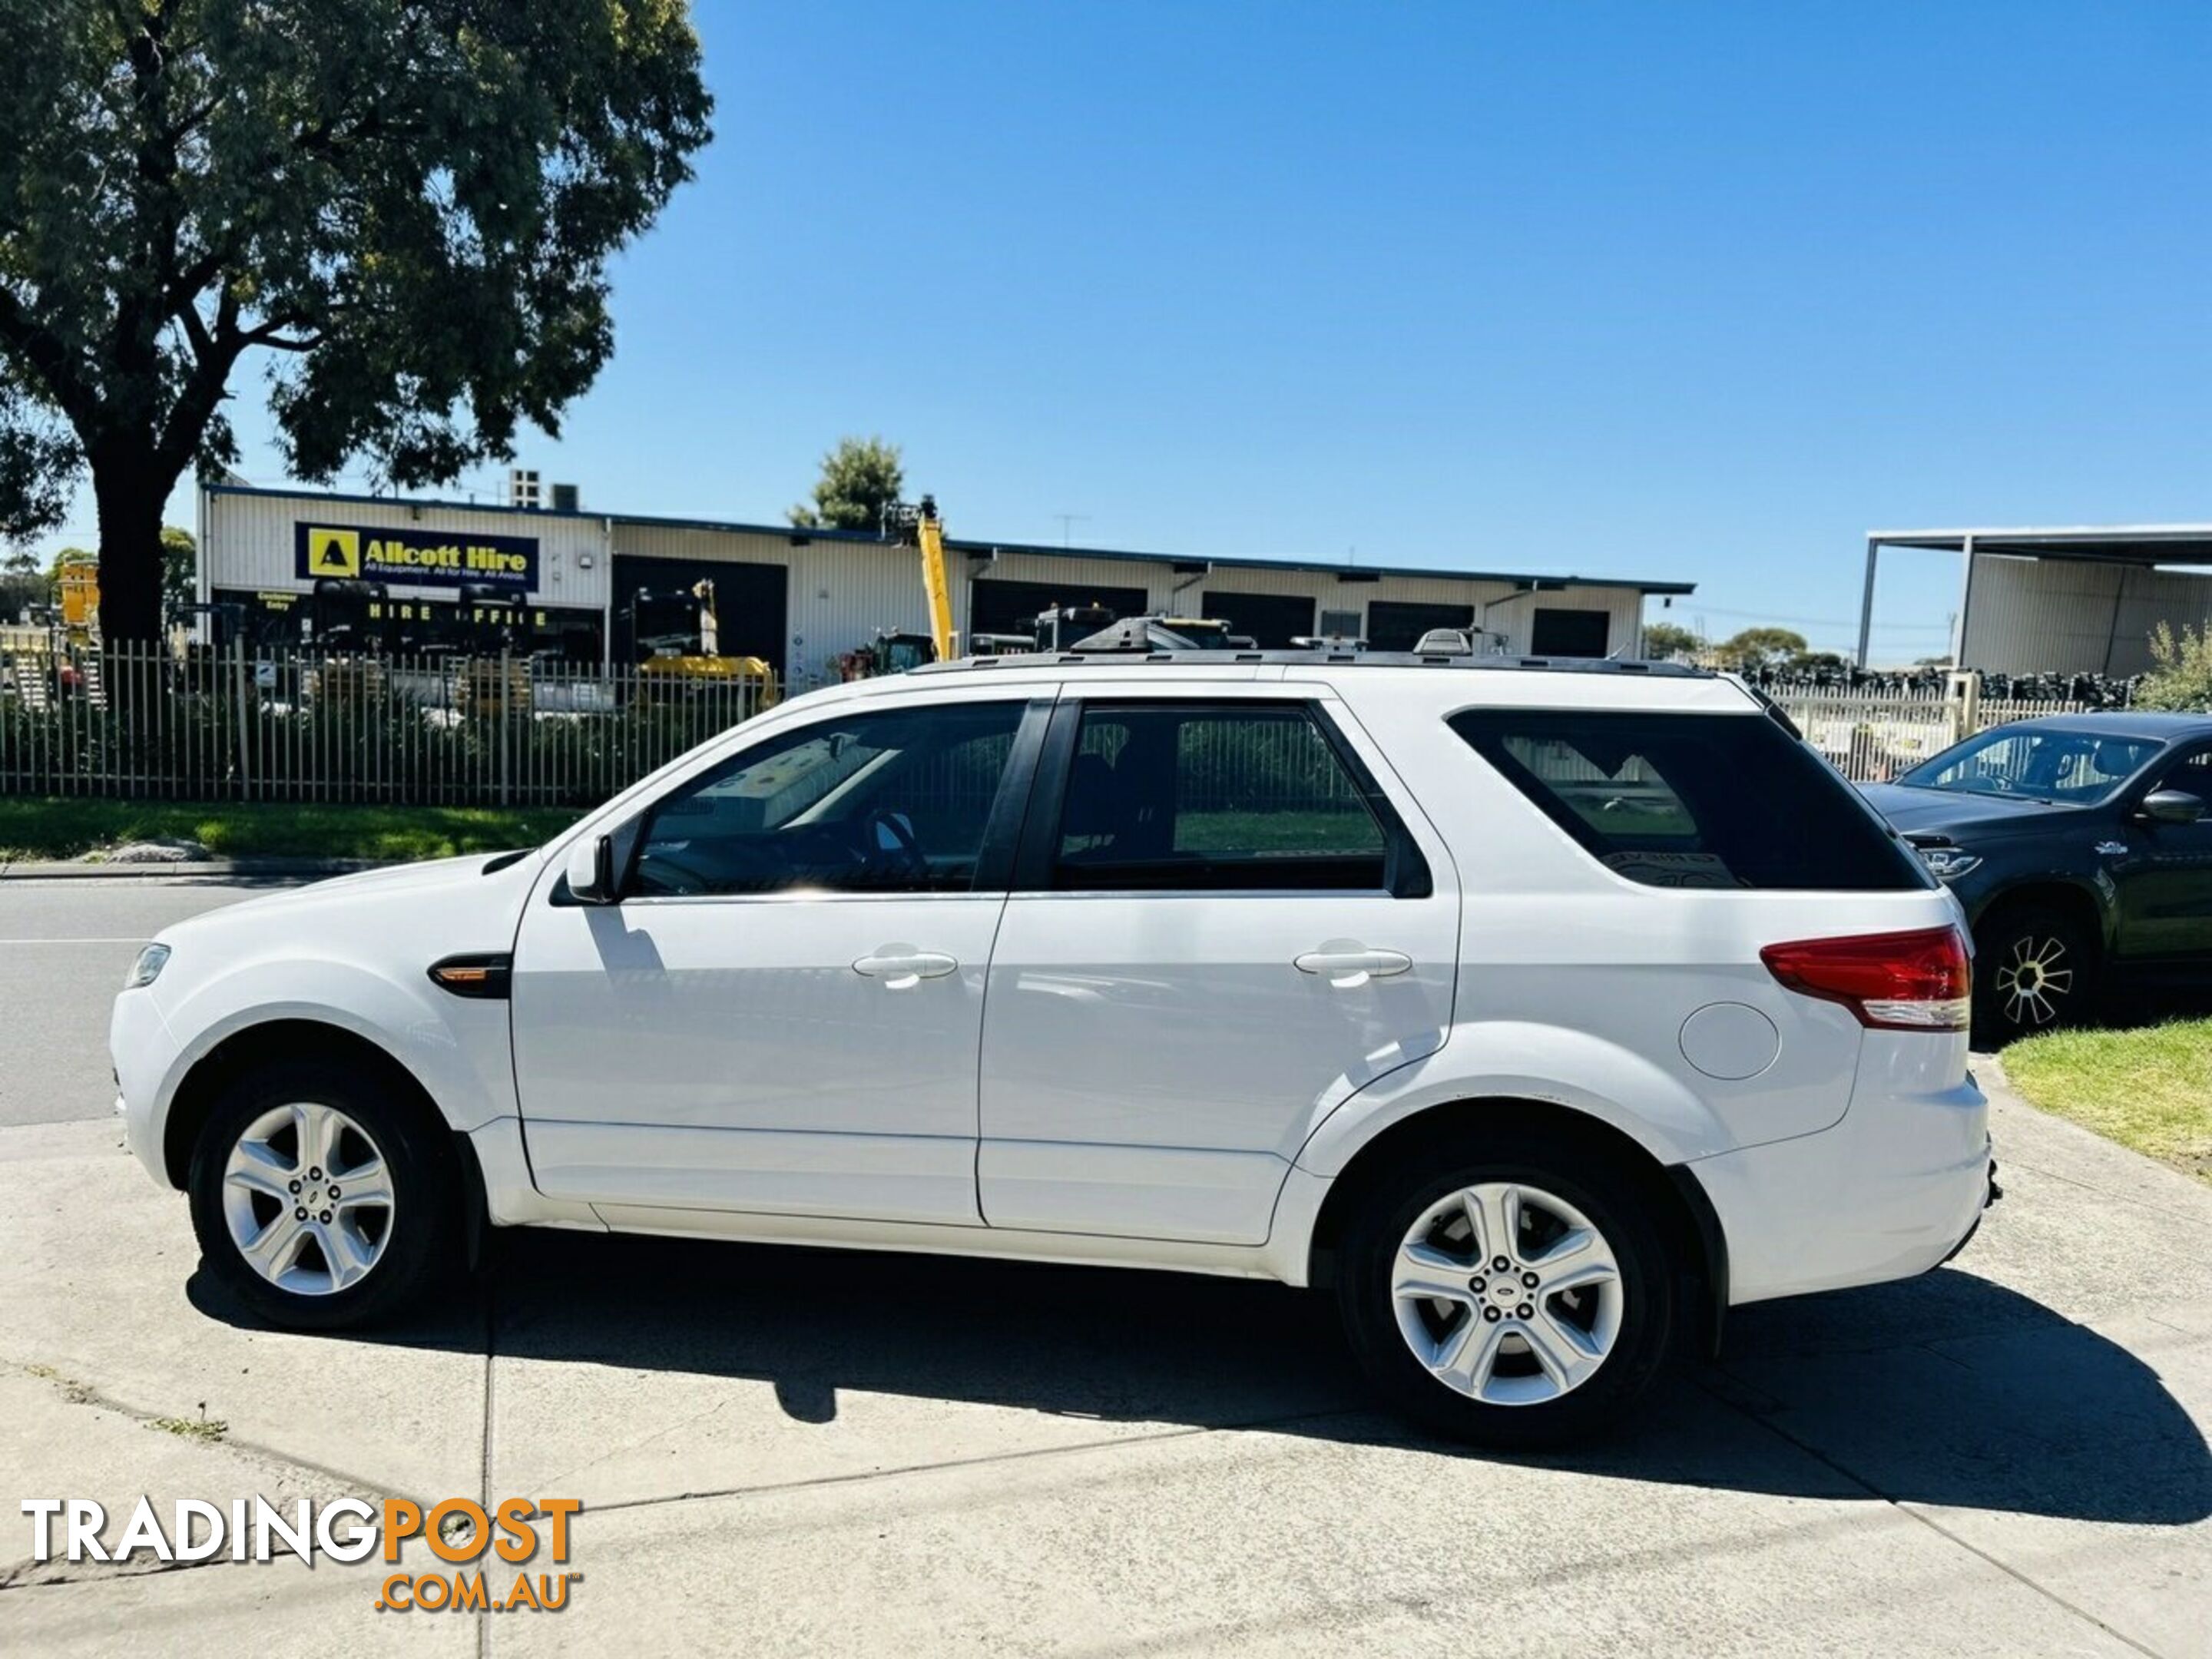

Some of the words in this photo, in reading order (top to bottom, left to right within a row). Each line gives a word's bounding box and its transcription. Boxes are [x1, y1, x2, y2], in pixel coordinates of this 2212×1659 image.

[320, 539, 349, 567] A
[365, 540, 461, 568] Allcott
[465, 546, 527, 571] Hire
[257, 591, 298, 601] Customer
[266, 601, 290, 611] Entry
[369, 603, 431, 620] HIRE
